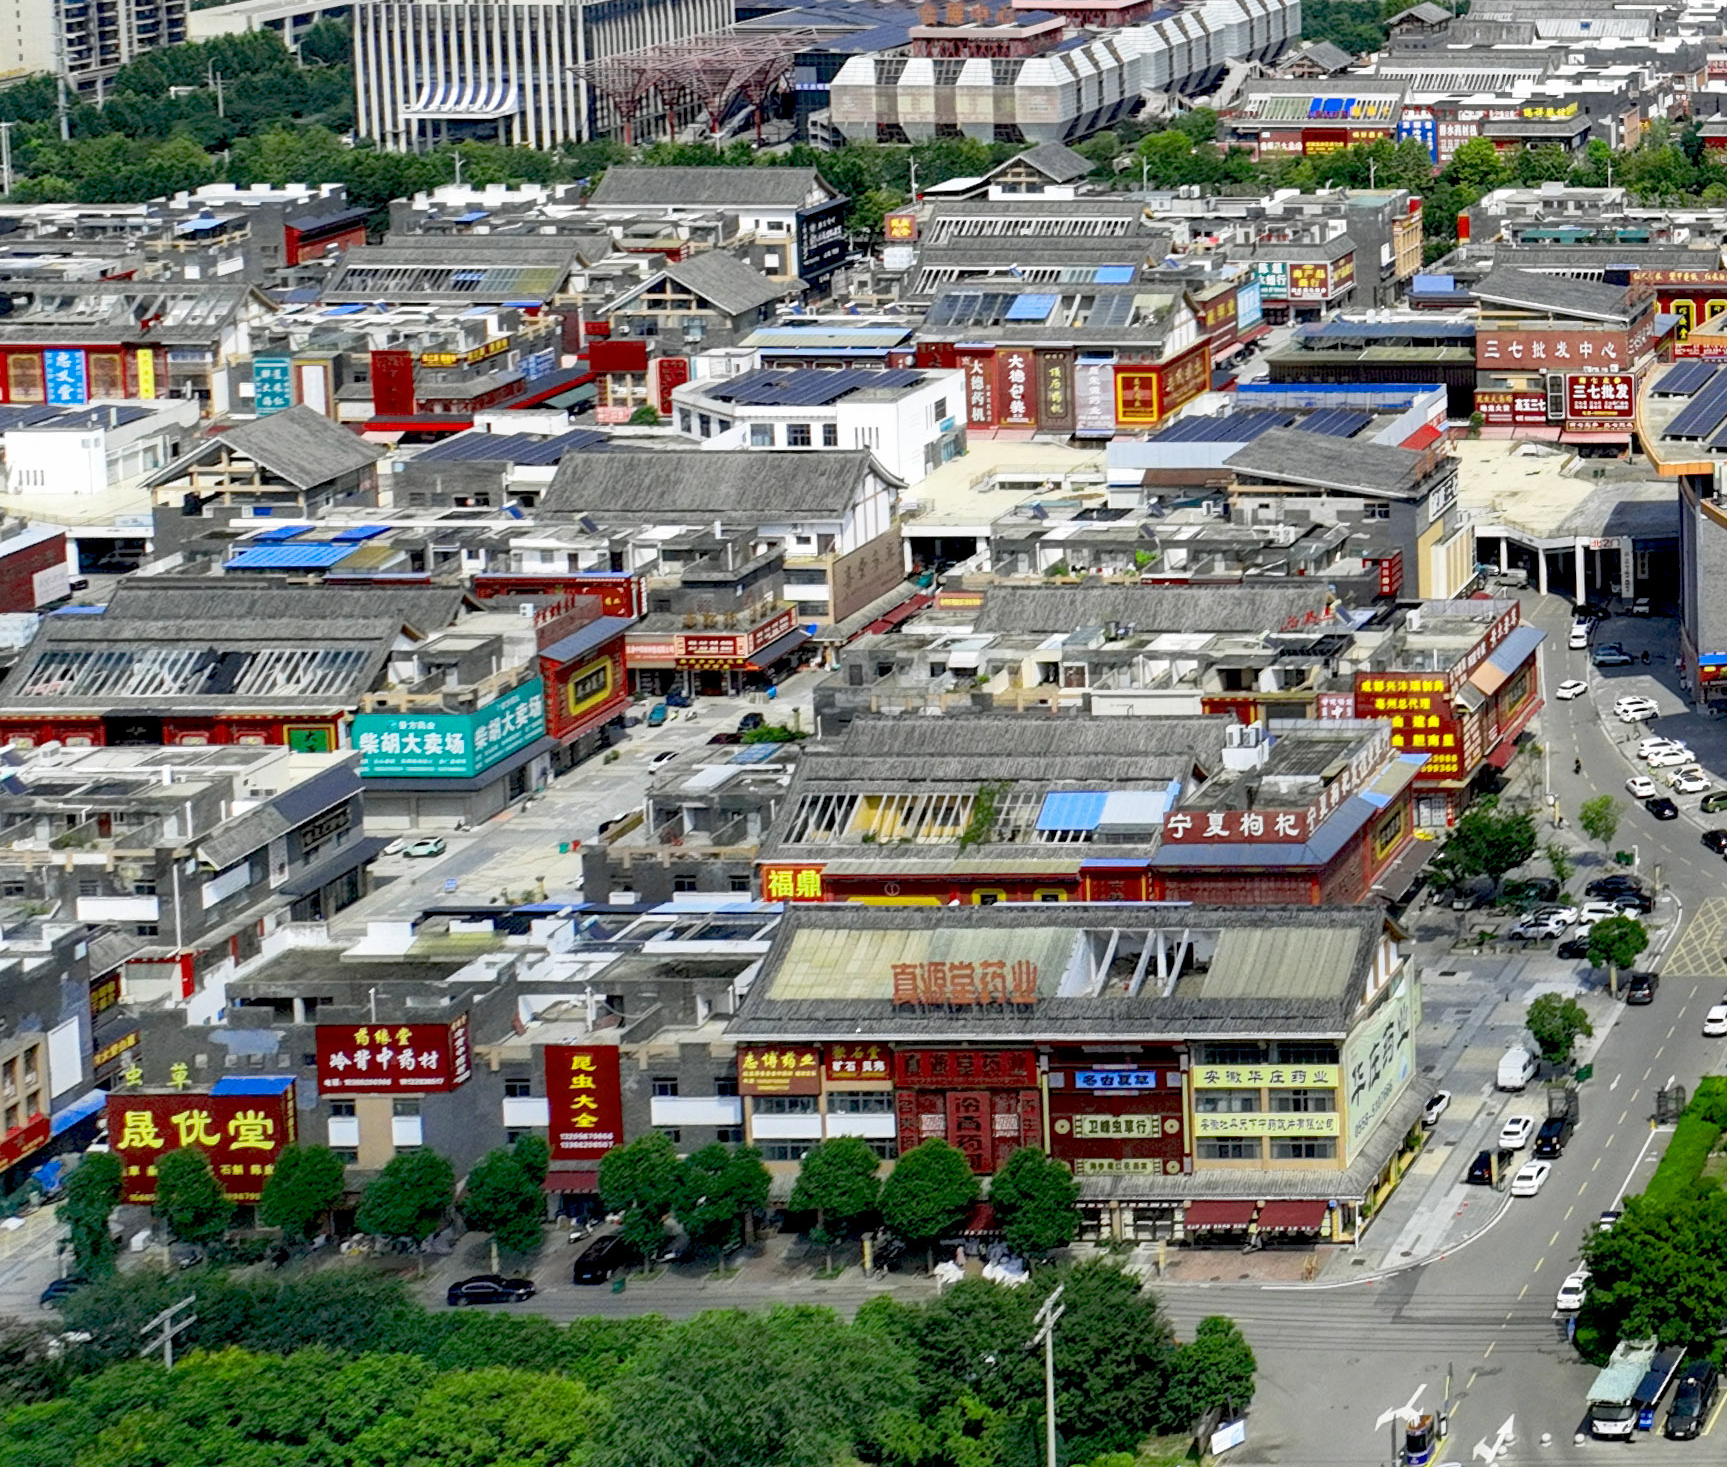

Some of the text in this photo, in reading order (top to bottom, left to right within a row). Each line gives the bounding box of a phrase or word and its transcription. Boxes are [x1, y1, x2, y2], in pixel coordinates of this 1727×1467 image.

[1484, 340, 1617, 359] 三七批发中心
[1573, 384, 1629, 399] 三七批发
[359, 732, 465, 755] 柴胡大卖场
[1168, 812, 1300, 838] 宁夏枸杞
[769, 870, 822, 897] 福鼎
[890, 959, 1038, 1006] 真源堂药业
[329, 1046, 439, 1072] 冷背中药材
[123, 1063, 193, 1090] 虫草
[1203, 1070, 1330, 1085] 安徽华庄药业
[569, 1054, 600, 1128] 昆虫大全
[117, 1108, 277, 1151] 晟优堂
